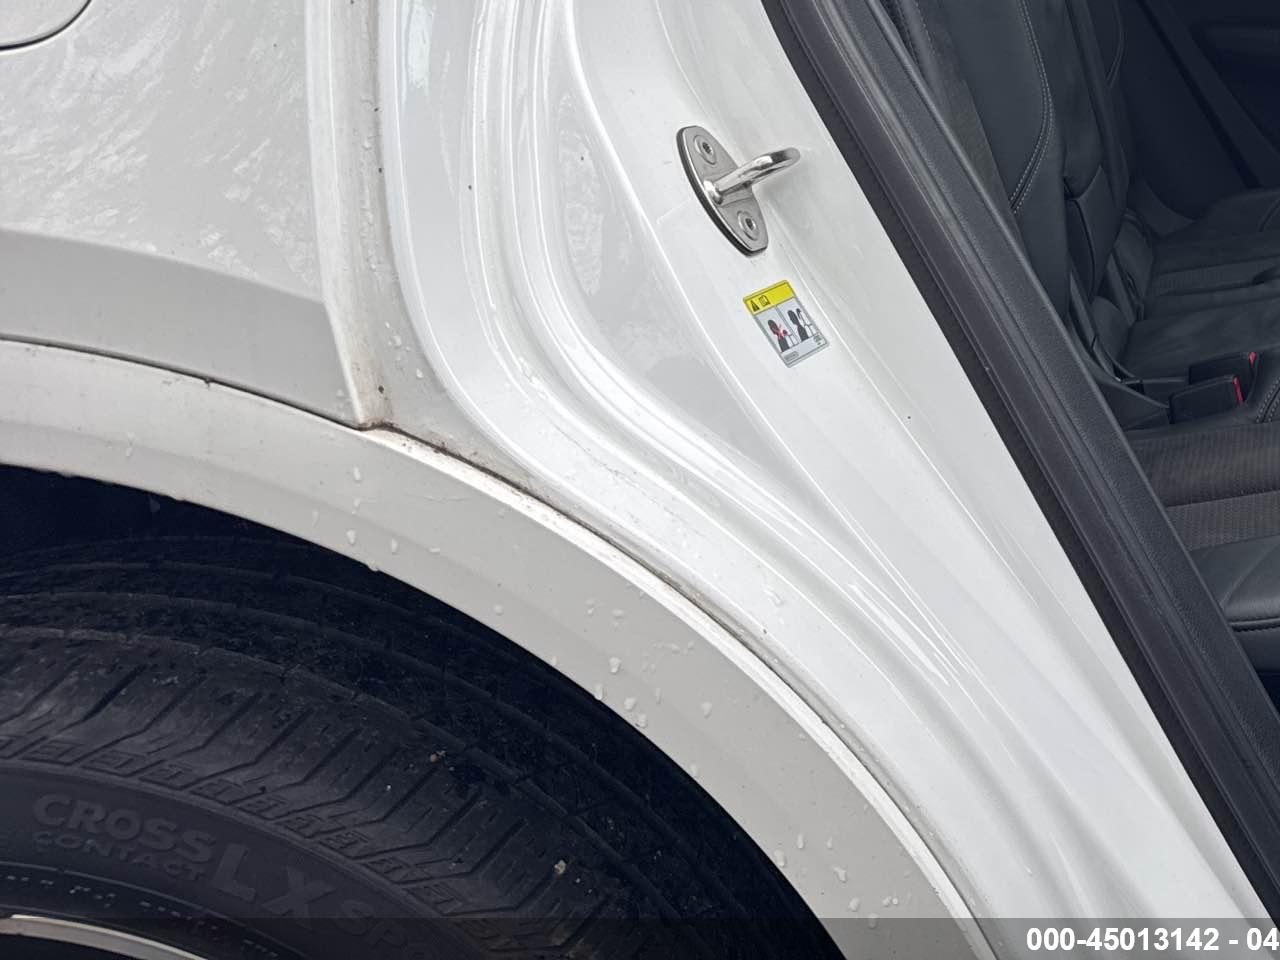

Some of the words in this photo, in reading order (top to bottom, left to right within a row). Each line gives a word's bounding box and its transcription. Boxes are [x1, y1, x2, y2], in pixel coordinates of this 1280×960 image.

[33, 794, 216, 863] CROSS
[33, 830, 208, 881] CONTACT
[211, 844, 338, 930] LX
